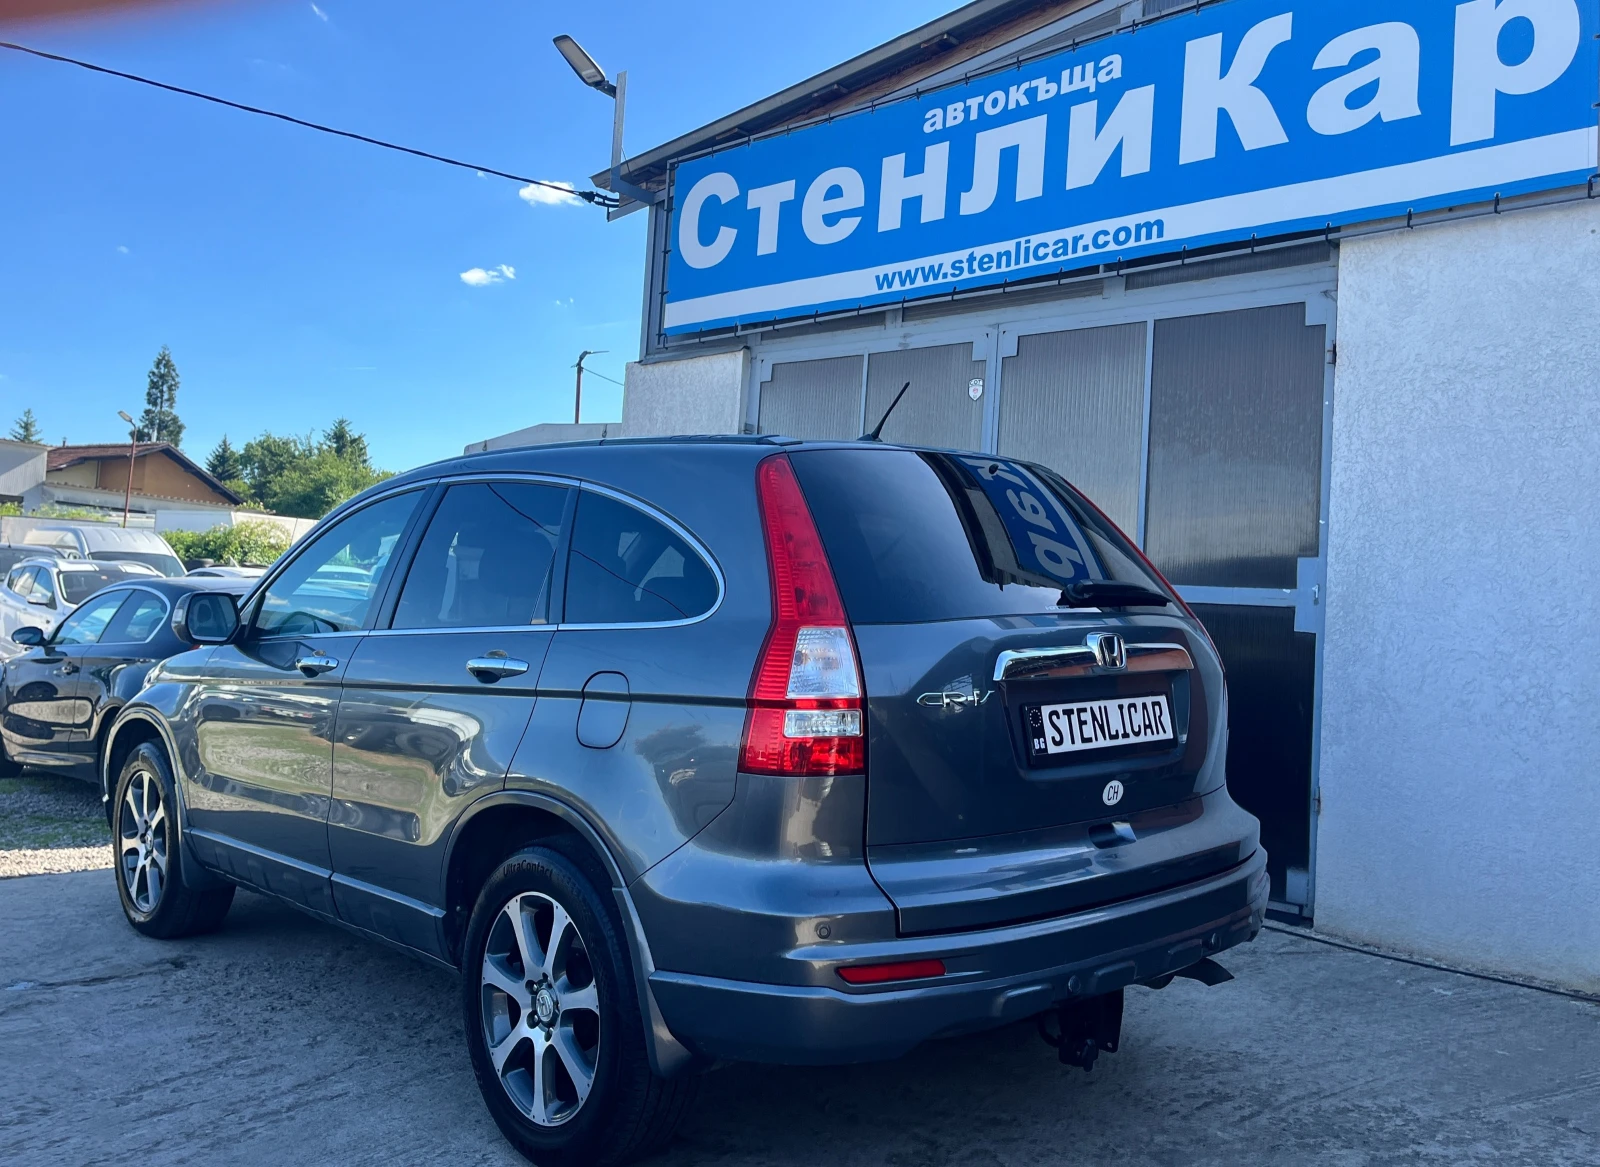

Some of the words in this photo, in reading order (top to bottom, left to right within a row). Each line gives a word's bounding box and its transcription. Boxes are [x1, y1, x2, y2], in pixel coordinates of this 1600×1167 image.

[922, 53, 1123, 134] автокъща
[875, 218, 1165, 292] www.stenlicar.com
[1033, 738, 1046, 750] BG
[1048, 700, 1167, 747] STENLICAR
[1107, 784, 1120, 801] CH
